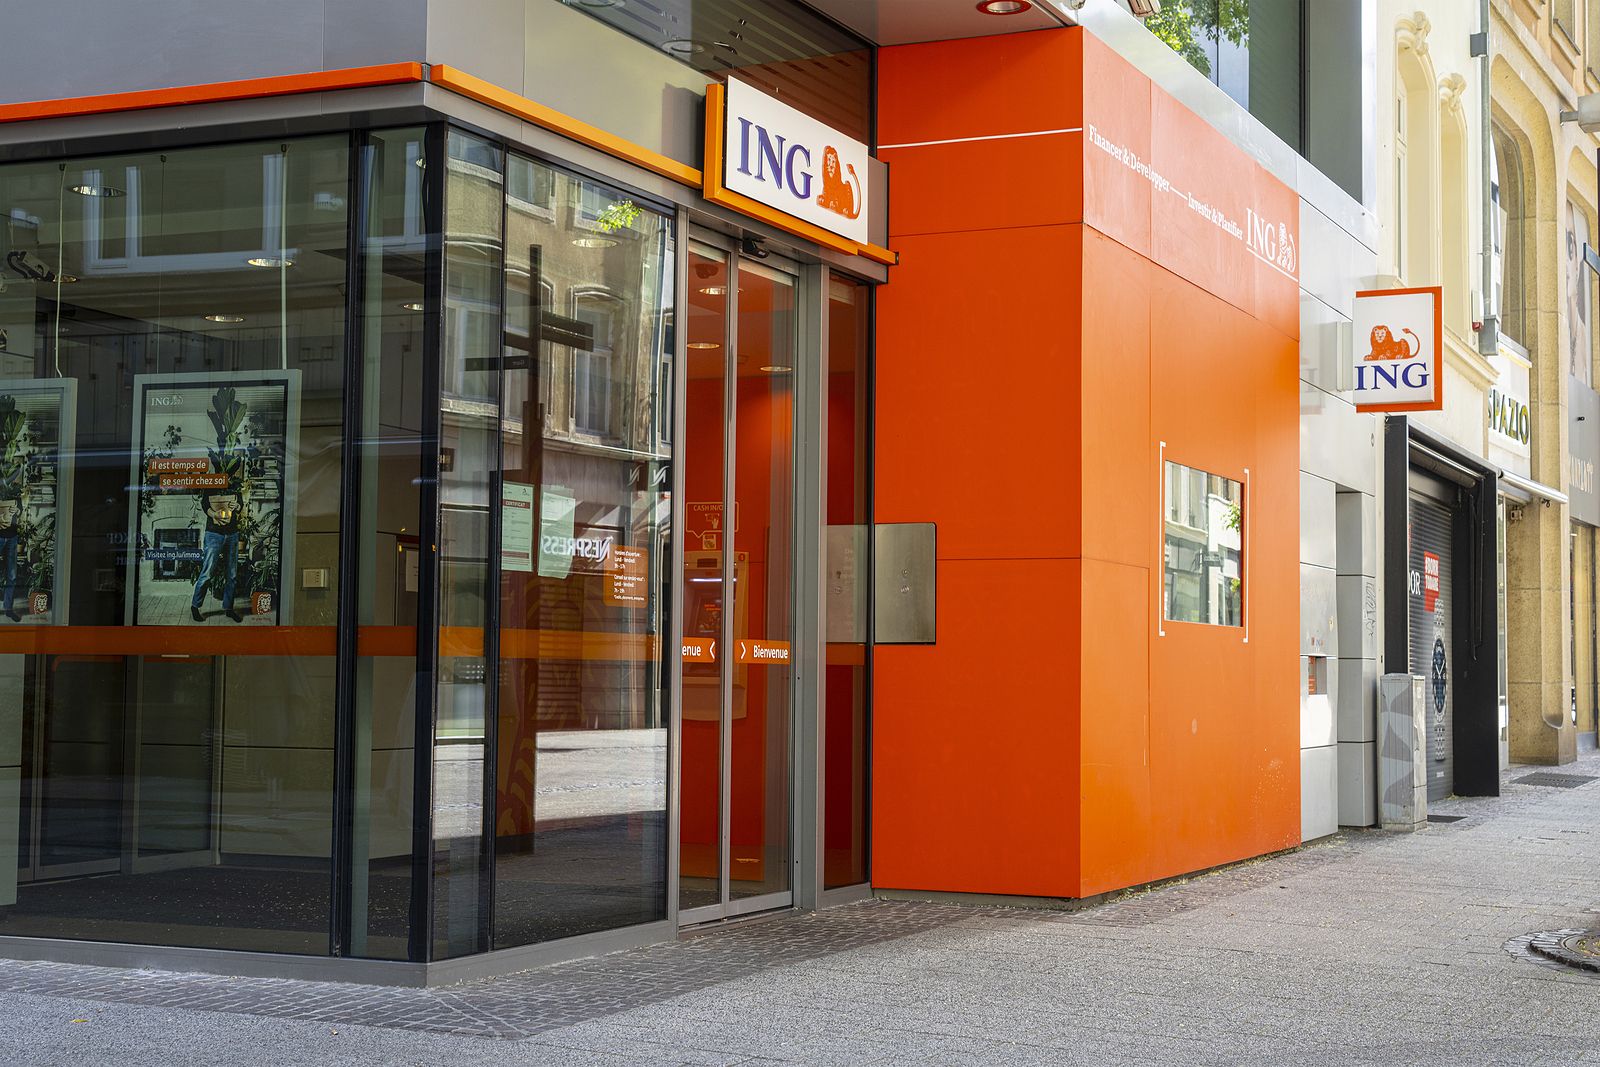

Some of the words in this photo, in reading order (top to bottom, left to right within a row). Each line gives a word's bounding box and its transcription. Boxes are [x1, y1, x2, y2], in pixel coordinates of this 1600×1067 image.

[737, 117, 813, 199] ING
[1088, 124, 1123, 161] Financer
[1130, 151, 1170, 192] Développer
[1188, 191, 1212, 221] Investir
[1246, 207, 1276, 261] ING
[1354, 362, 1430, 391] ING
[151, 397, 170, 407] ING
[151, 461, 157, 470] Il
[158, 461, 170, 470] est
[171, 461, 195, 472] temps
[196, 460, 206, 469] de
[162, 478, 172, 486] se
[172, 477, 194, 486] sentir
[195, 477, 213, 485] chez
[214, 476, 226, 485] soi
[505, 500, 527, 508] CERTIFICAT
[1408, 570, 1421, 596] OR
[753, 645, 789, 659] Bienvenue
